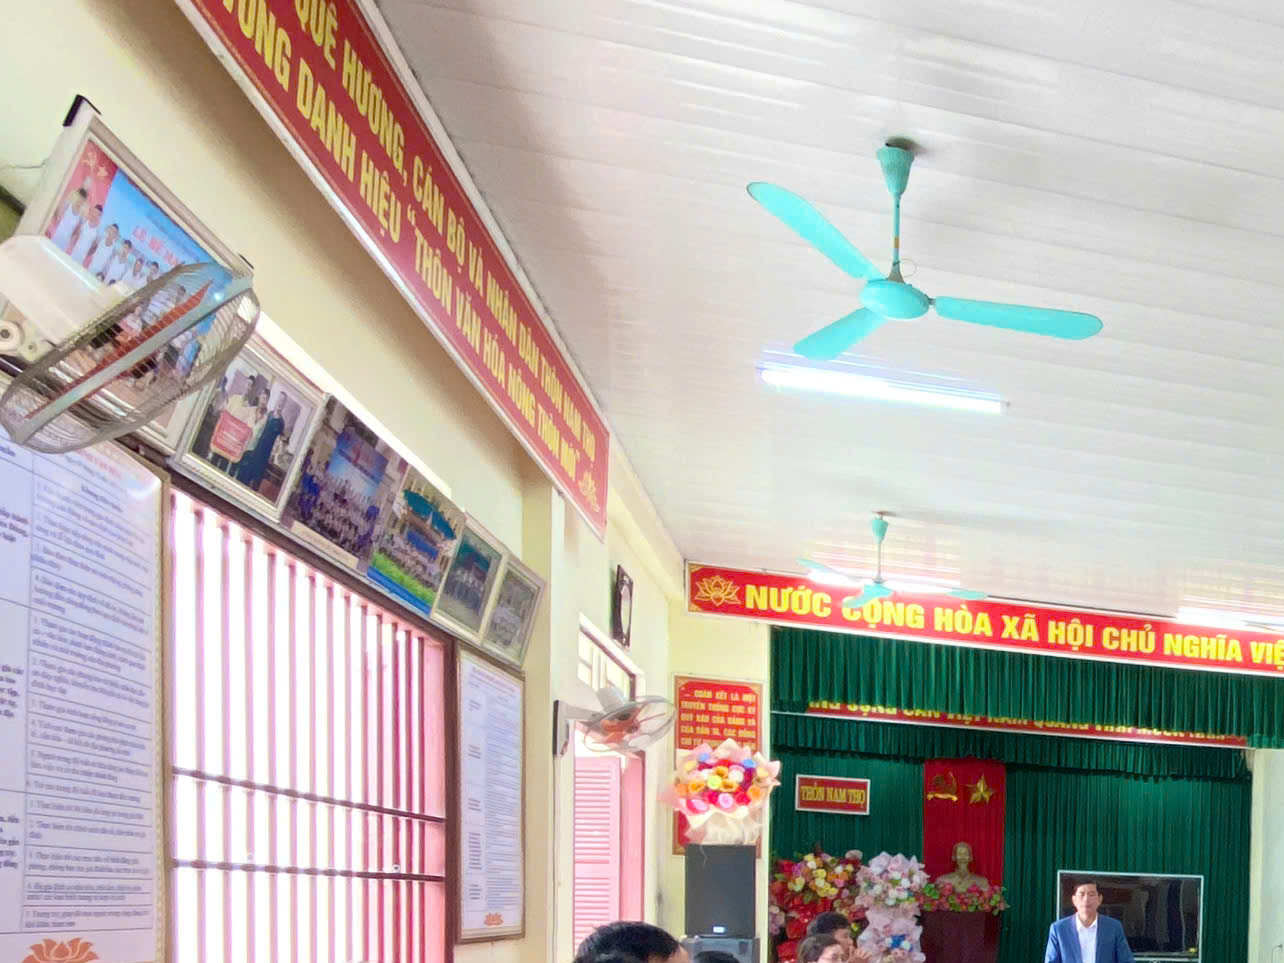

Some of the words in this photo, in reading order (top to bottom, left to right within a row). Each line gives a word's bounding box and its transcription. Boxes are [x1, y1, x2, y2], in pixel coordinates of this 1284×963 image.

[222, 0, 292, 92] NG
[296, 57, 356, 183] DANH
[359, 150, 401, 243] HIỆU
[456, 285, 481, 355] VĂN
[507, 362, 536, 428] NÔNG
[342, 40, 408, 187] HƯƠNG,
[412, 155, 445, 236] CÁN
[447, 207, 465, 274] BỘ
[468, 239, 484, 297] VÀ
[486, 270, 517, 347] NHÂN
[519, 321, 540, 379] DÂN
[745, 584, 832, 618] NƯỚC
[933, 604, 993, 637] HÒA
[1000, 613, 1040, 642] XÃ
[1048, 618, 1094, 651] HỘI
[1102, 623, 1156, 654] CHỦ
[1163, 633, 1243, 662] NGHĨA
[826, 786, 847, 802] NAM
